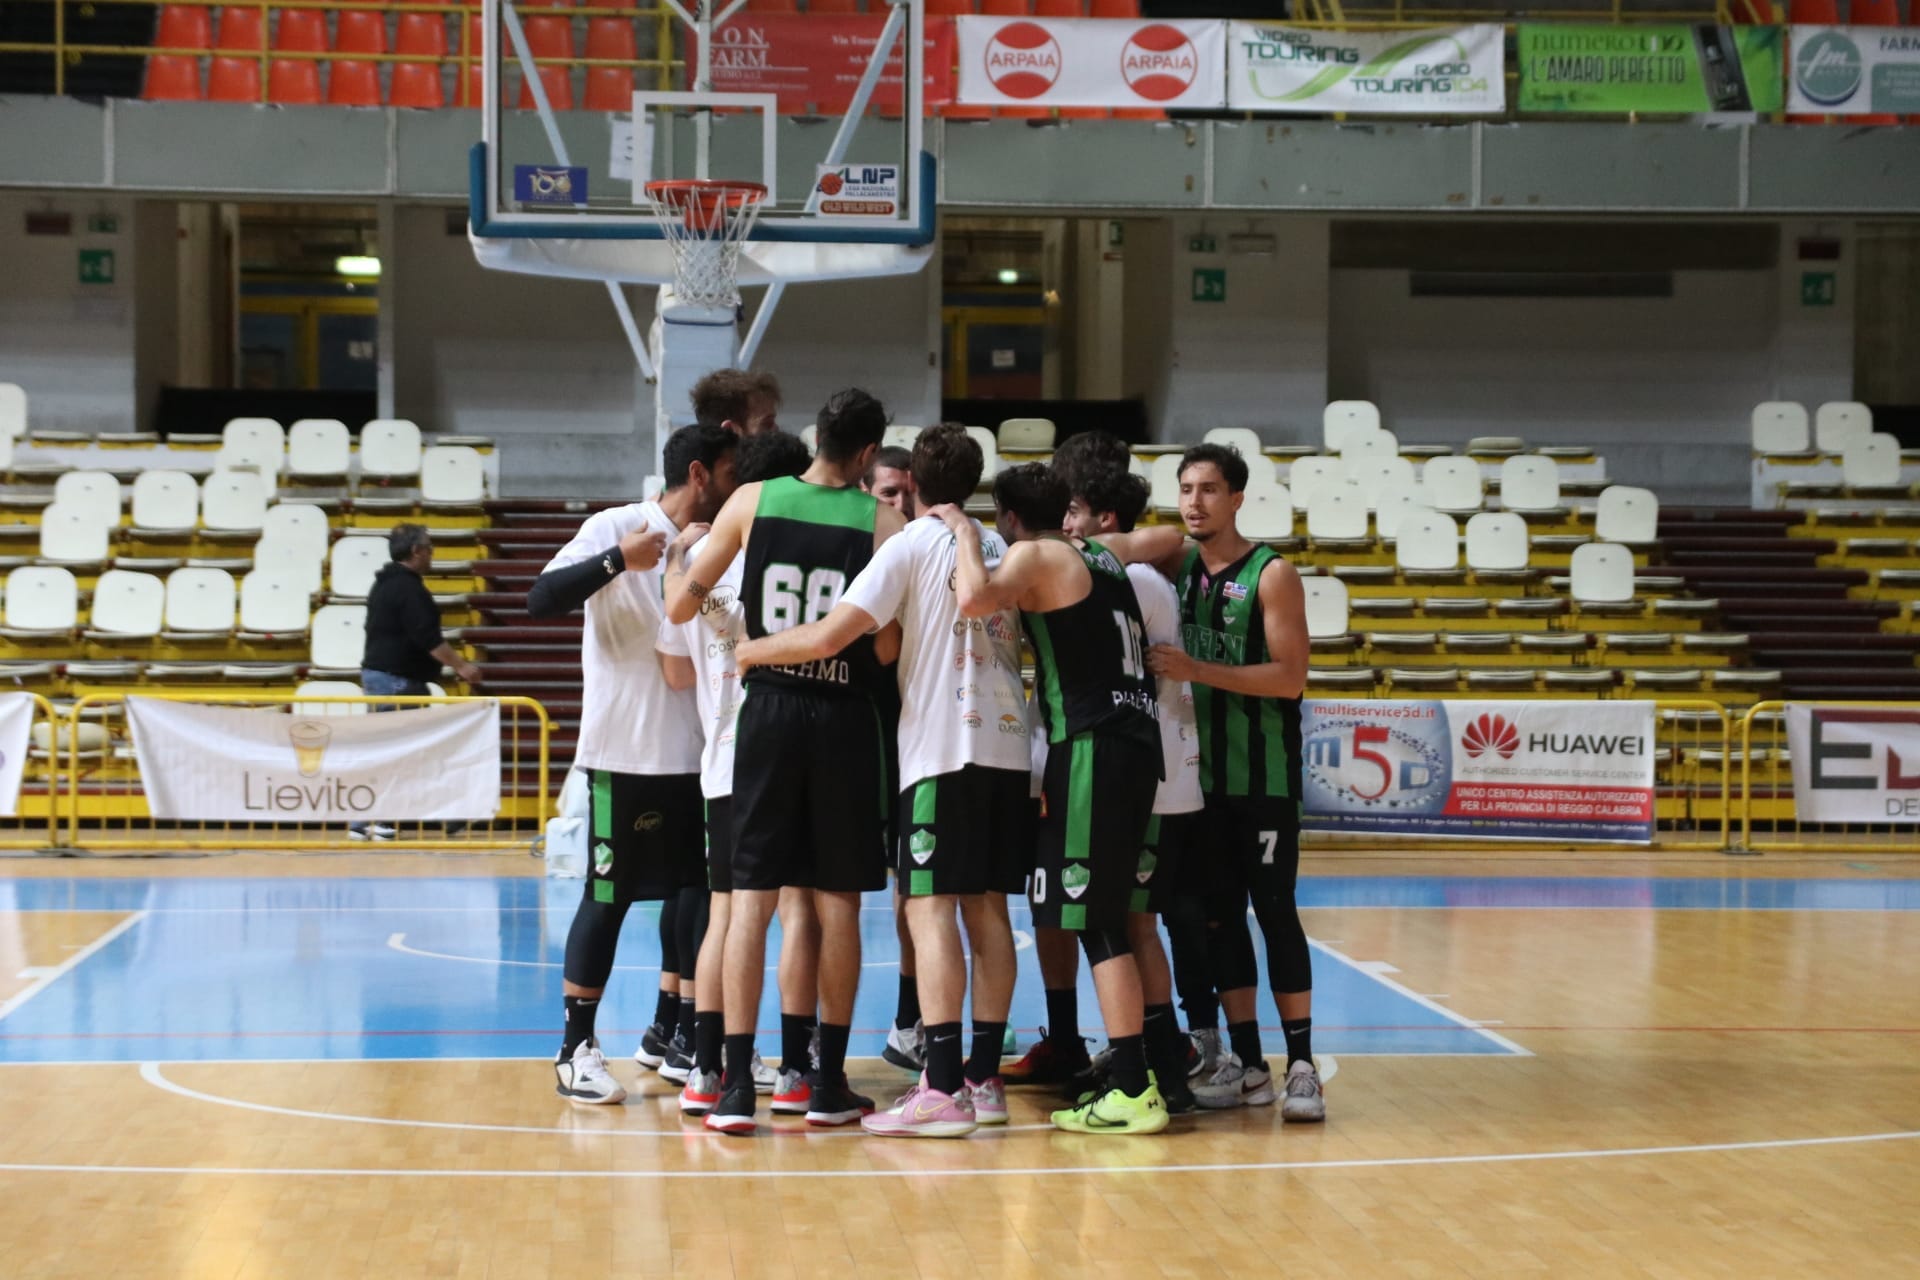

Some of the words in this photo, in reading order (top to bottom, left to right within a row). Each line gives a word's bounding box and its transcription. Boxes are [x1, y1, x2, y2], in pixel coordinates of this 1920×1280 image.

[990, 53, 1056, 67] ARPAIA
[1242, 42, 1359, 64] TOURING
[1126, 55, 1192, 70] ARPAIA
[1609, 55, 1685, 83] PERFETTO
[845, 168, 895, 184] LNP
[708, 638, 739, 659] Cost
[1314, 704, 1436, 718] multiservice5d.it
[1528, 732, 1645, 756] HUAWEI
[245, 771, 376, 811] Lievito
[1456, 787, 1485, 798] UNICO
[1487, 788, 1525, 799] CENTRO
[1526, 789, 1582, 801] ASSISTENZA
[1584, 791, 1648, 803] AUTORIZZATO
[1461, 801, 1480, 810] PER
[1481, 802, 1494, 811] LA
[1496, 802, 1545, 813] PROVINCIA
[1546, 803, 1556, 813] DI
[1558, 803, 1593, 814] REGGIO
[1595, 804, 1642, 815] CALABRIA
[1886, 798, 1920, 816] DE
[1258, 830, 1278, 864] 7
